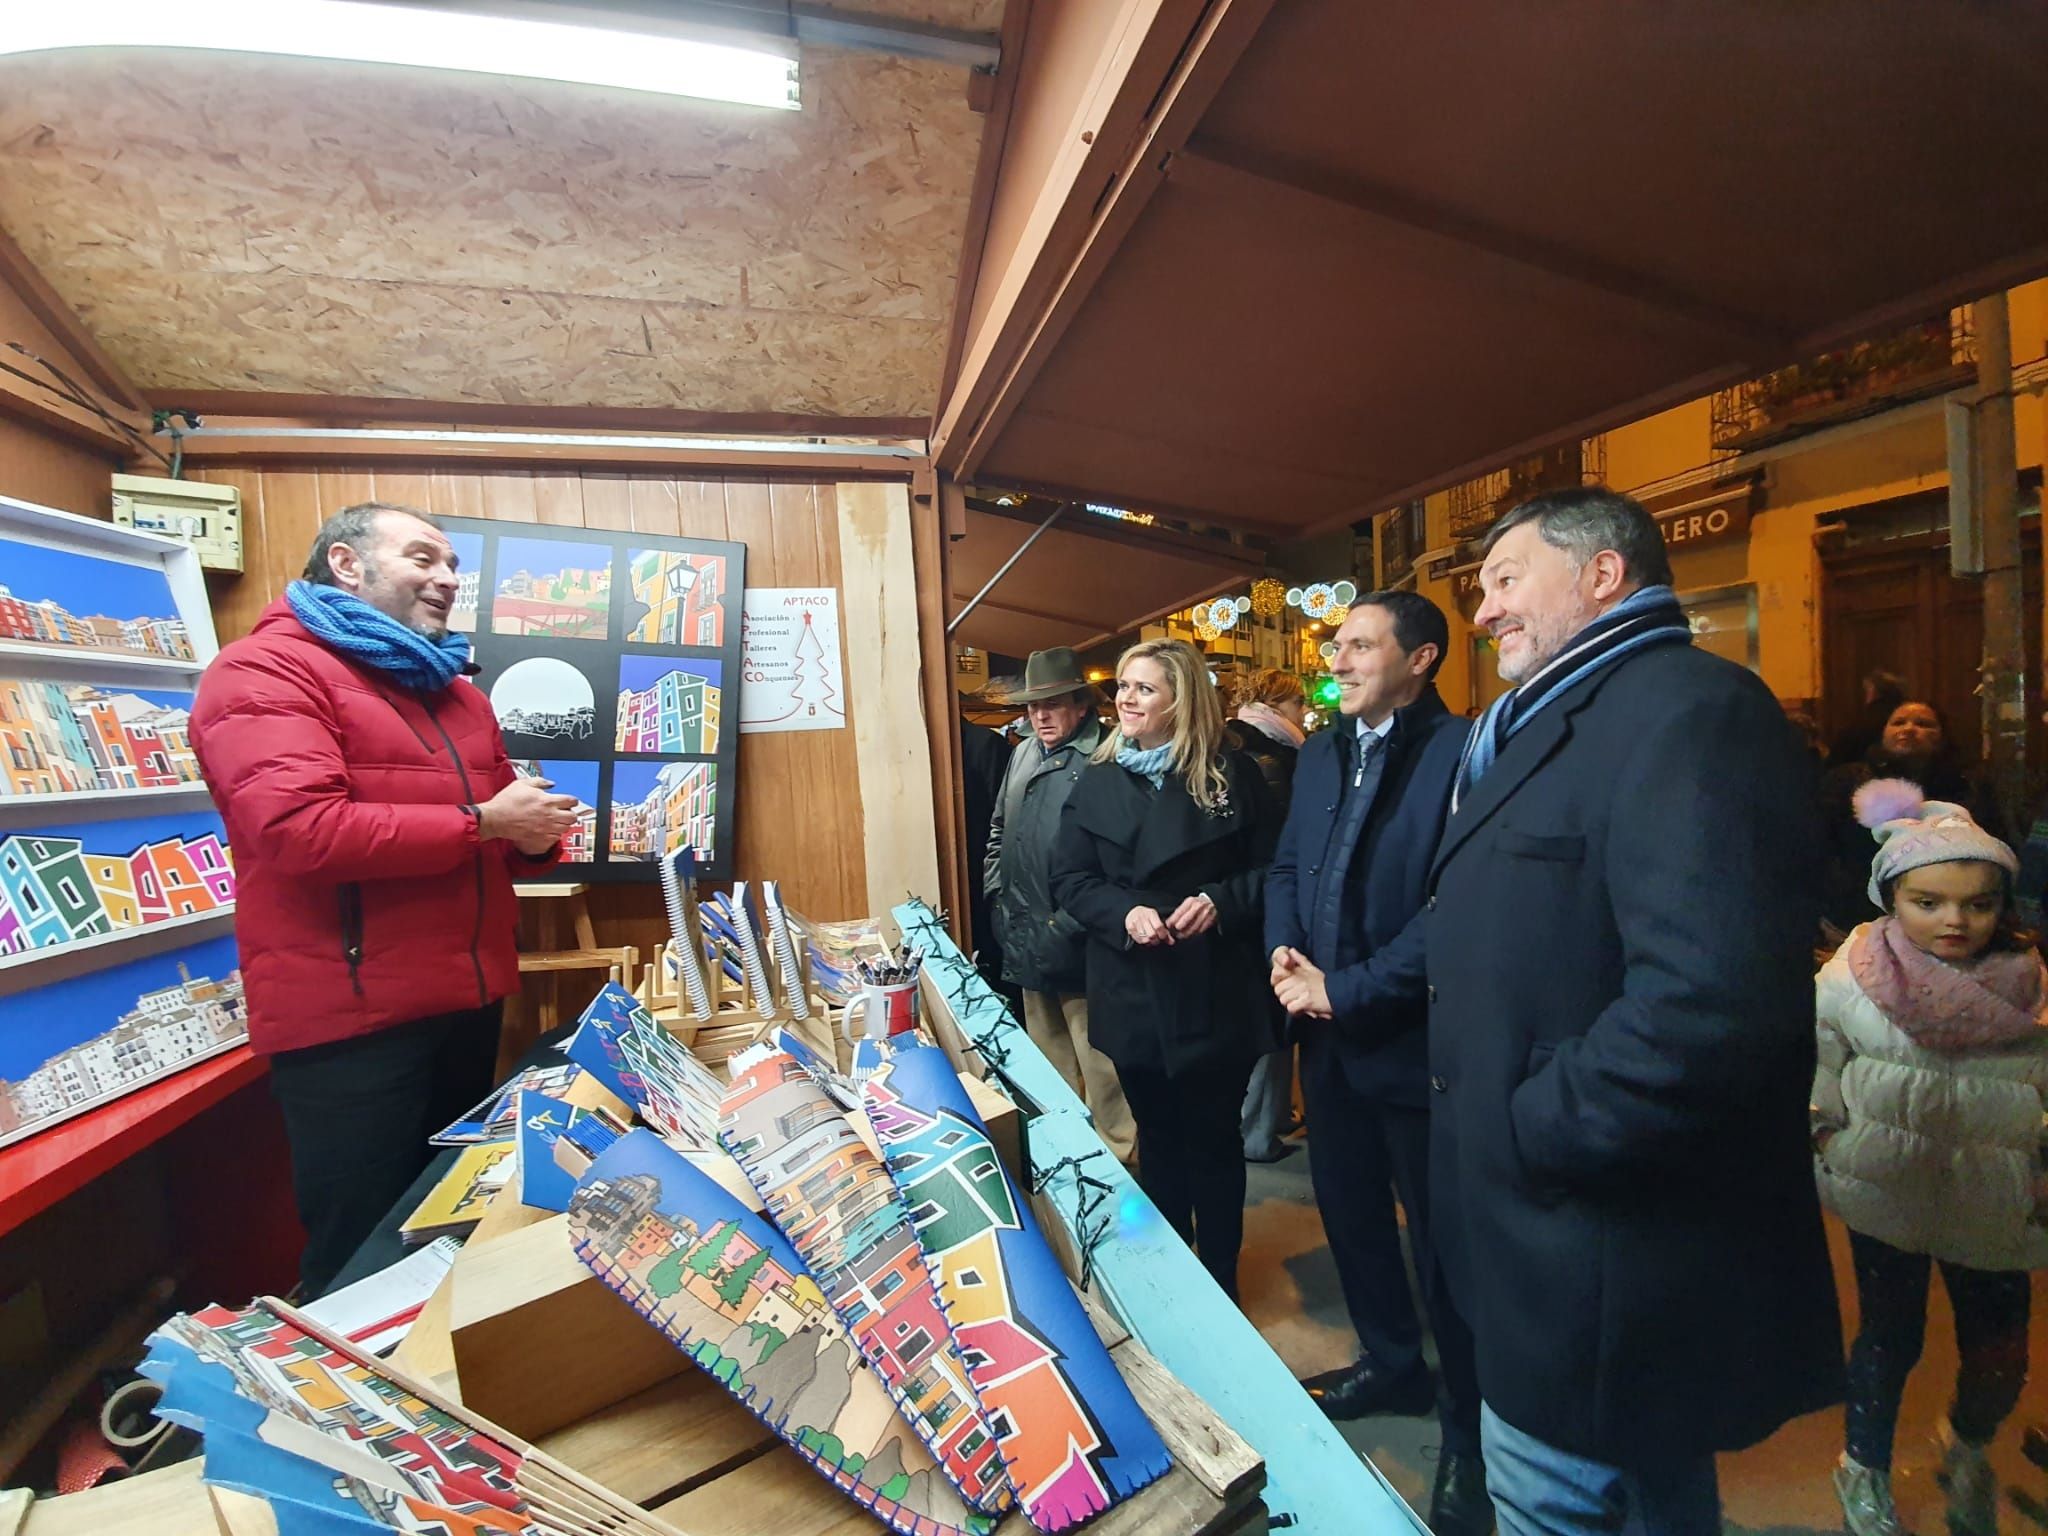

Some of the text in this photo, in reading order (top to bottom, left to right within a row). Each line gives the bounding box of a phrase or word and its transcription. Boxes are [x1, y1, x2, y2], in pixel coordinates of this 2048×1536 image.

[1460, 573, 1481, 592] PA
[783, 596, 829, 606] APTACO
[741, 610, 790, 621] Asociación
[741, 624, 789, 636] Profesional
[741, 640, 777, 651] Talleres
[743, 657, 789, 668] Artesanos
